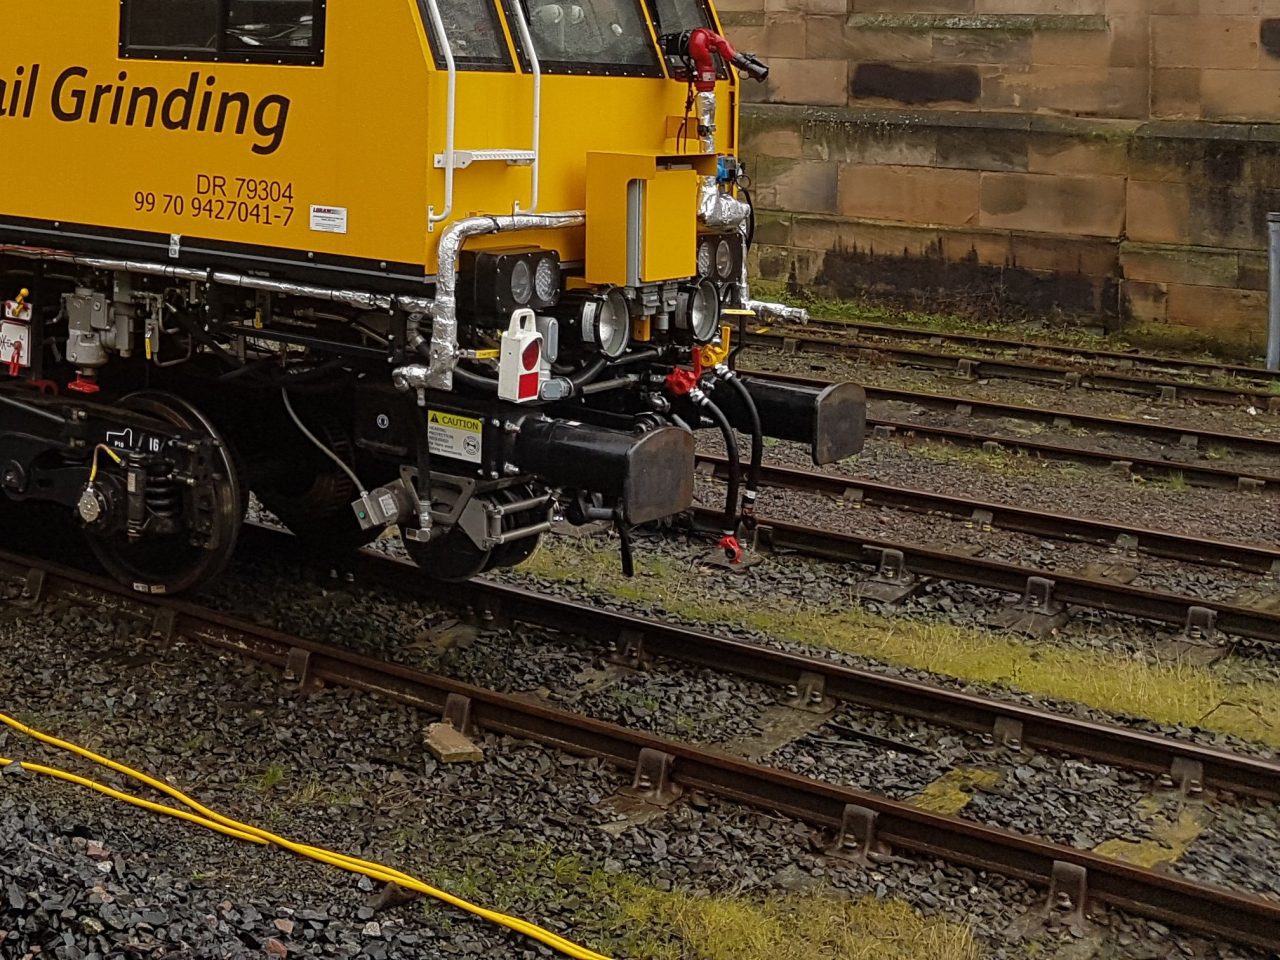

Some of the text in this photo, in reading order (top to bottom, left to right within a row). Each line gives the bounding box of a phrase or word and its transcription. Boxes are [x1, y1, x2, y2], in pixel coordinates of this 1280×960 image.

[50, 66, 291, 156] Grinding
[196, 174, 294, 204] DR 79304
[134, 191, 295, 227] 99 70 9427041-7
[442, 415, 479, 431] CAUTION
[149, 437, 160, 452] 16
